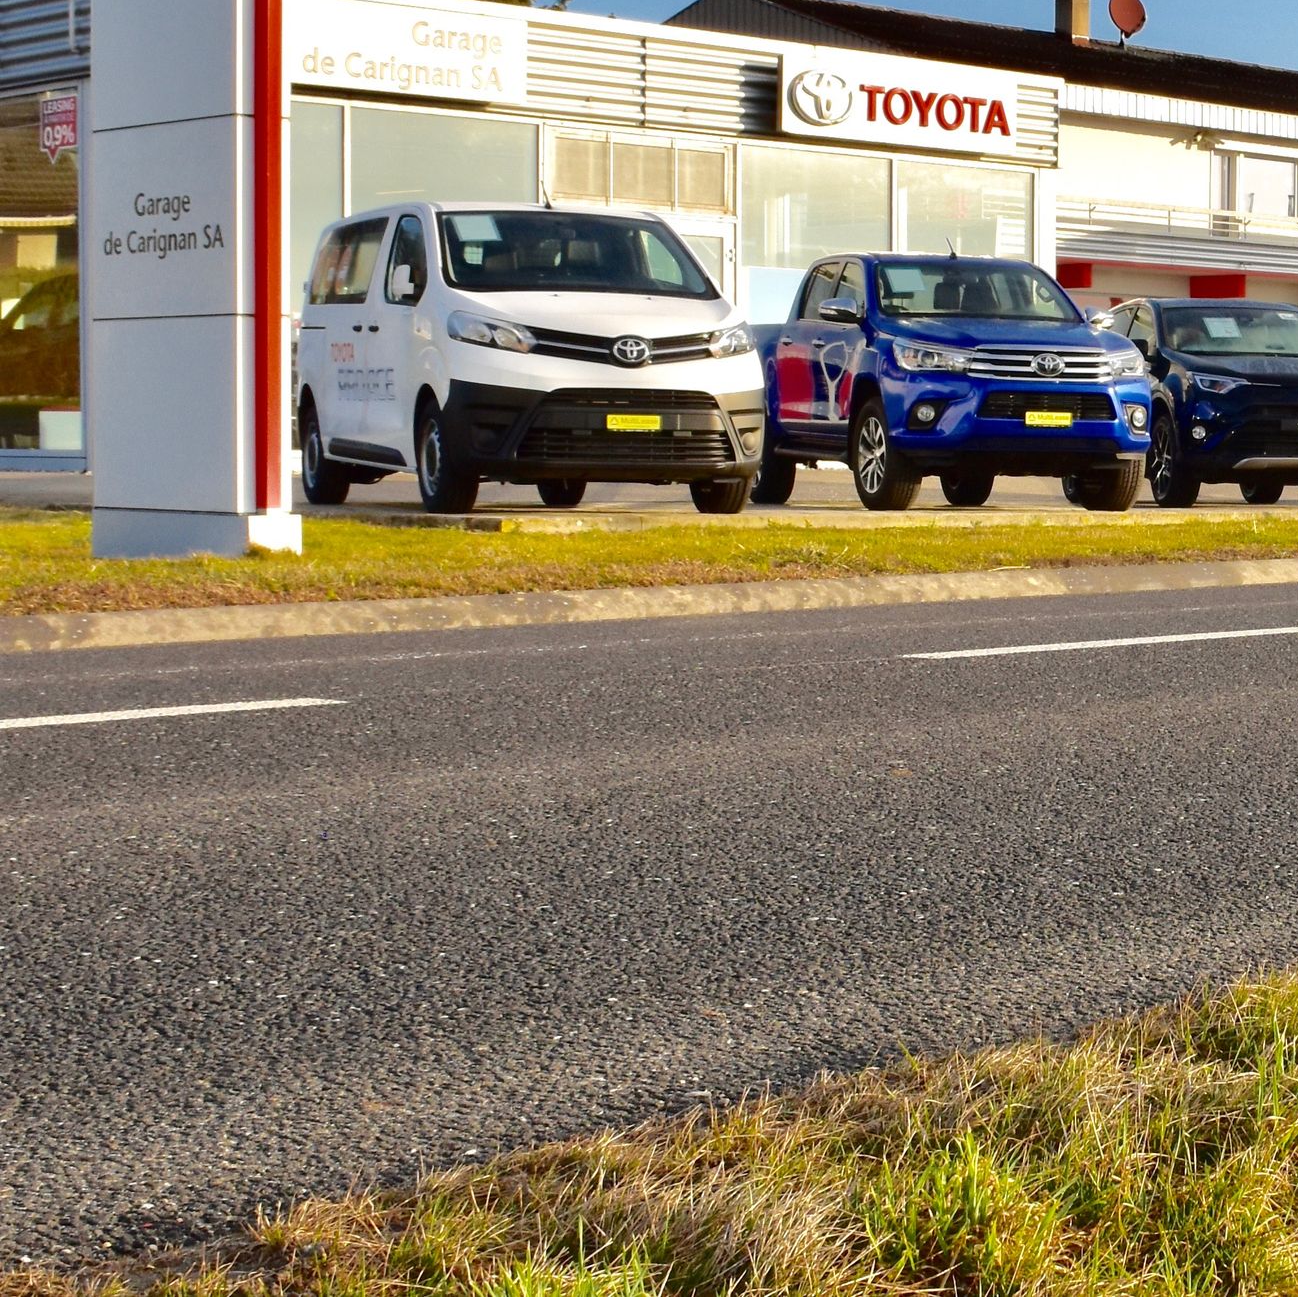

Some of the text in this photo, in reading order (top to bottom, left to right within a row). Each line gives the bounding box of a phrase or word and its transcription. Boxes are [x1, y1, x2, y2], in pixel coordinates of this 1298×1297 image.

[412, 21, 503, 60] Garage
[302, 47, 503, 91] de Carignan SA
[43, 98, 75, 114] LEASING
[859, 84, 1011, 136] TOYOTA
[43, 124, 75, 148] 0,9%
[134, 193, 191, 221] Garage
[104, 223, 224, 259] de Carignan SA
